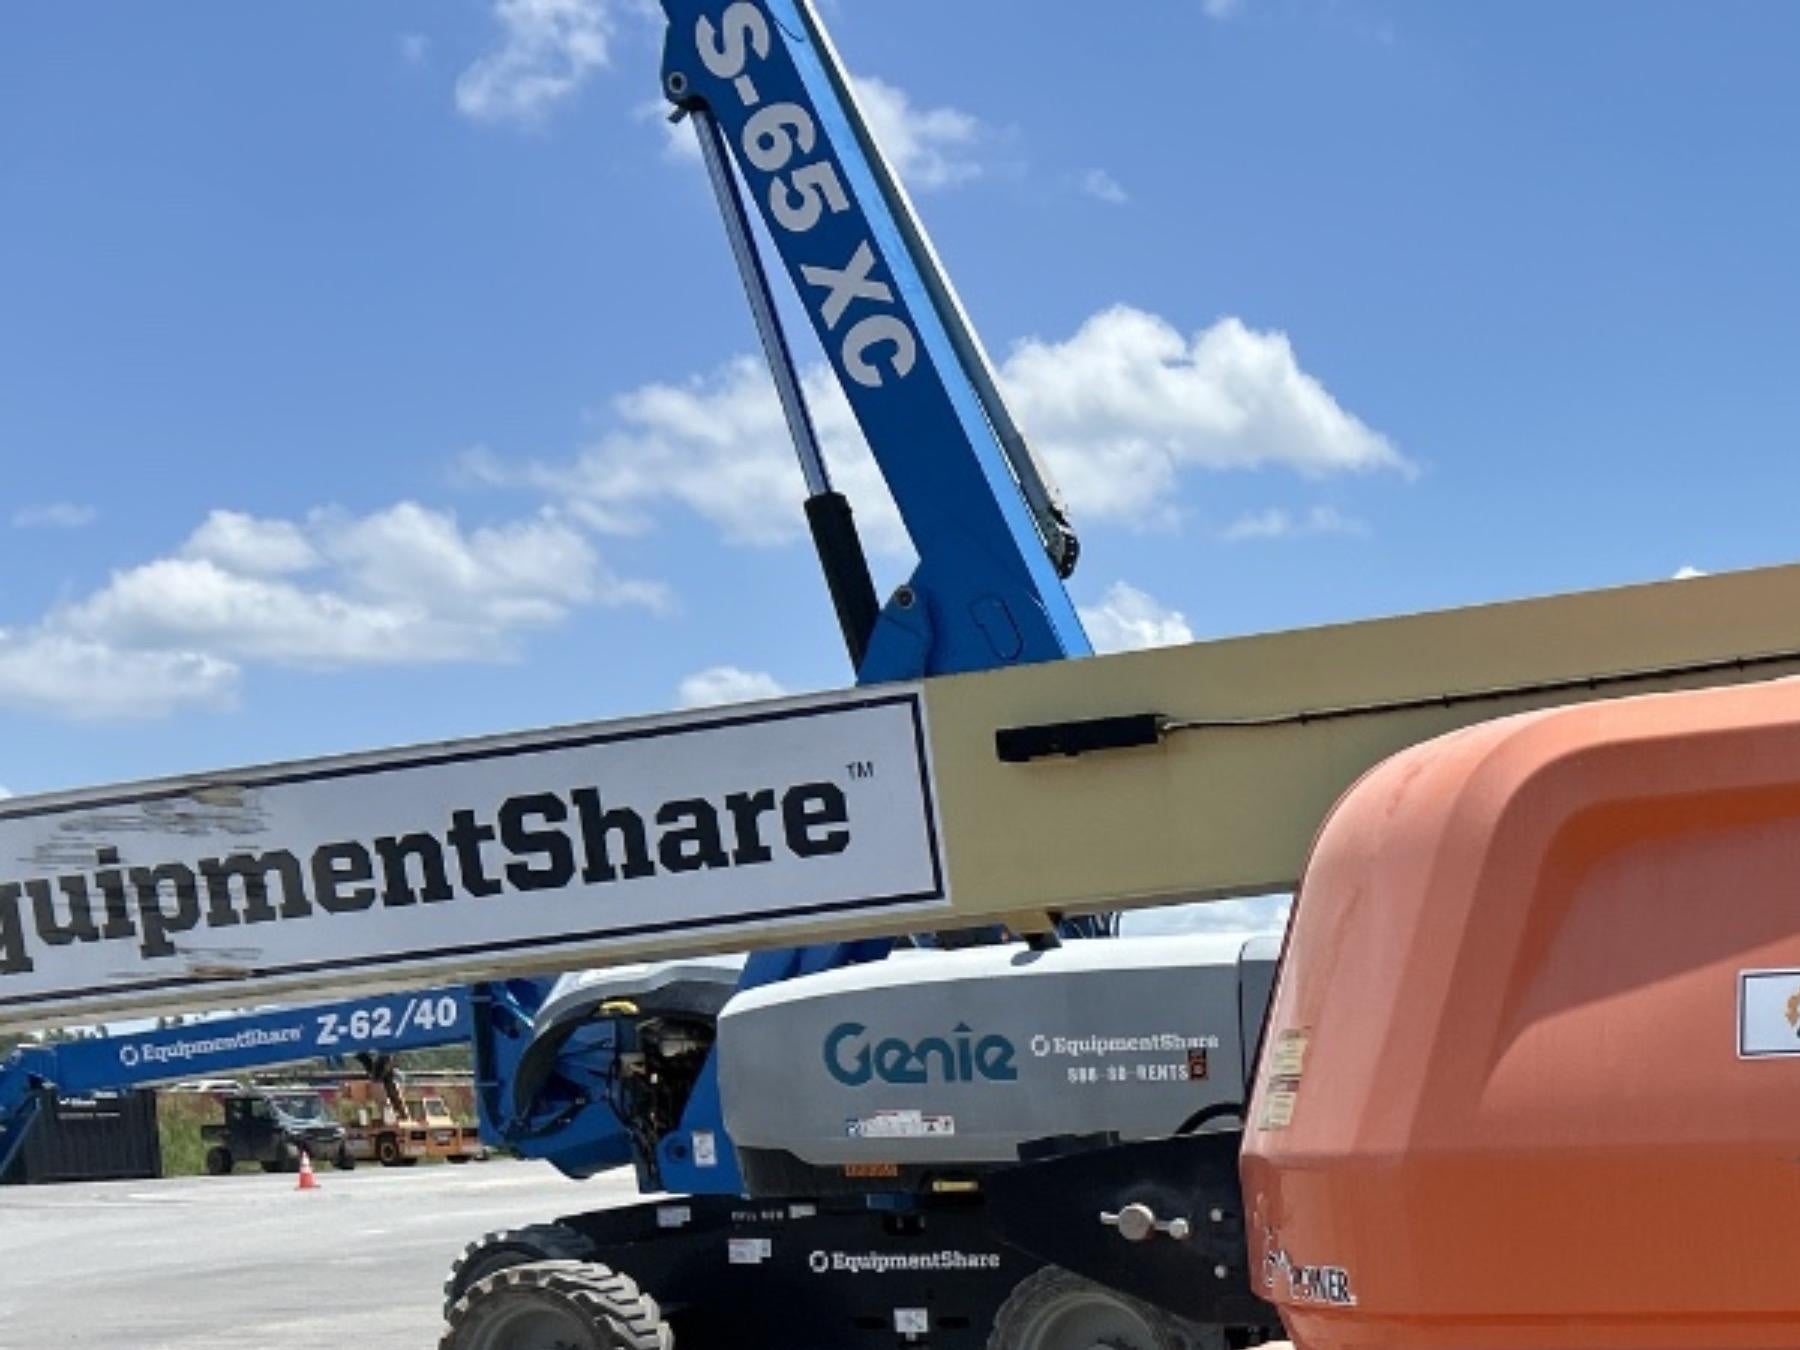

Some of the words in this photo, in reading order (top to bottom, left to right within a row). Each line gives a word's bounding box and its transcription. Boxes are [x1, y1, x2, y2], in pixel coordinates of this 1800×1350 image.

[695, 2, 849, 232] S-65
[800, 240, 916, 388] XC
[142, 1027, 301, 1063] EquipmentShare
[316, 997, 457, 1046] Z-62/40
[823, 1021, 1018, 1087] Genie
[1053, 1034, 1219, 1057] EquipmentShare
[831, 1250, 1000, 1273] EquipmentShare
